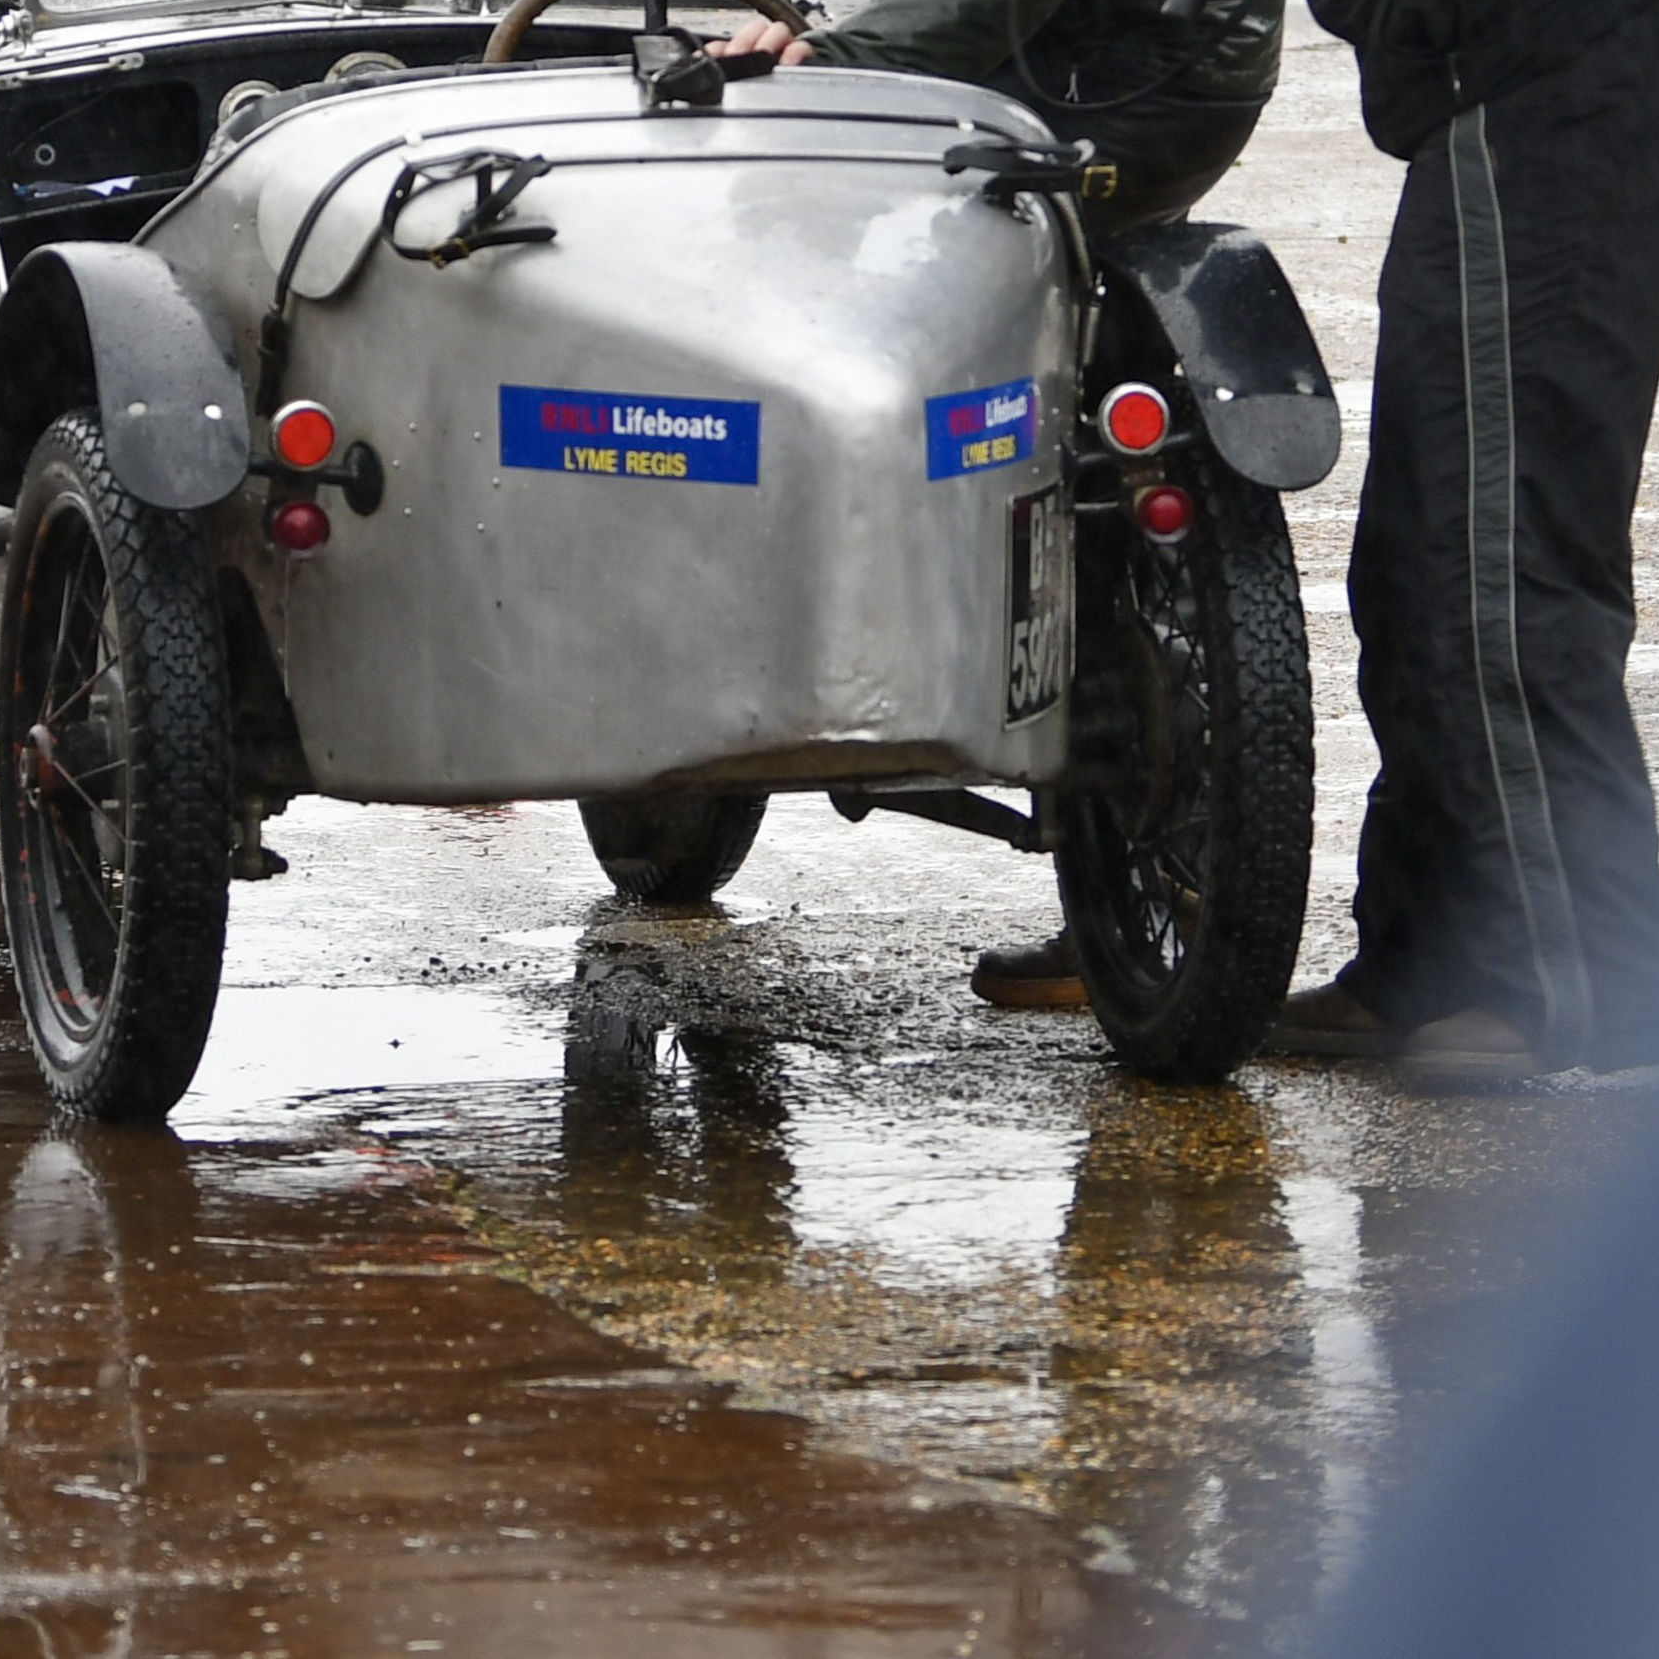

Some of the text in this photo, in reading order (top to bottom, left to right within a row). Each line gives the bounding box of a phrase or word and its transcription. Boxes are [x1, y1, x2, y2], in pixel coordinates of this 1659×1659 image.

[541, 403, 728, 441] RNLI Lifeboats
[563, 446, 688, 478] LYME REGIS
